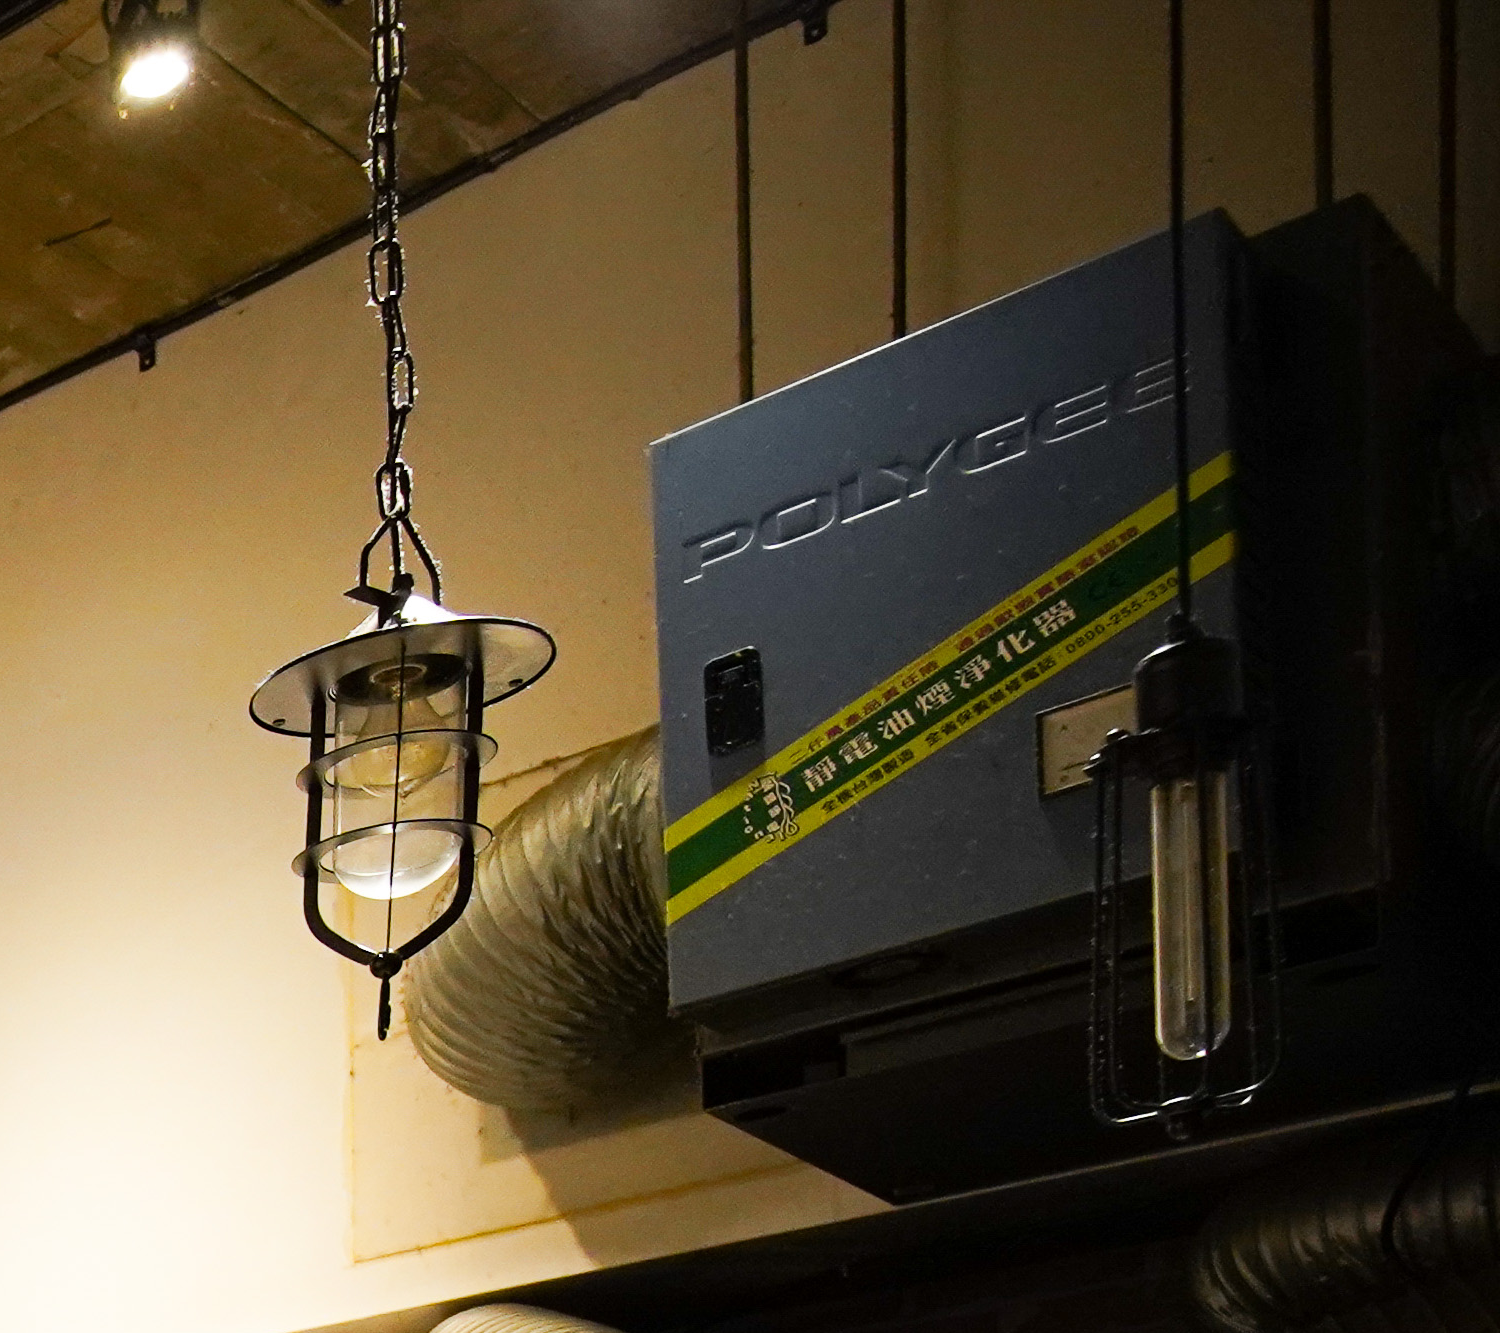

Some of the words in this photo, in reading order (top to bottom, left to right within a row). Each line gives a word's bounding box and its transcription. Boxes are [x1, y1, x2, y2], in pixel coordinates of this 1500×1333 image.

[681, 351, 1191, 583] POLYGEE
[802, 599, 1077, 793] 靜電油煙淨化器
